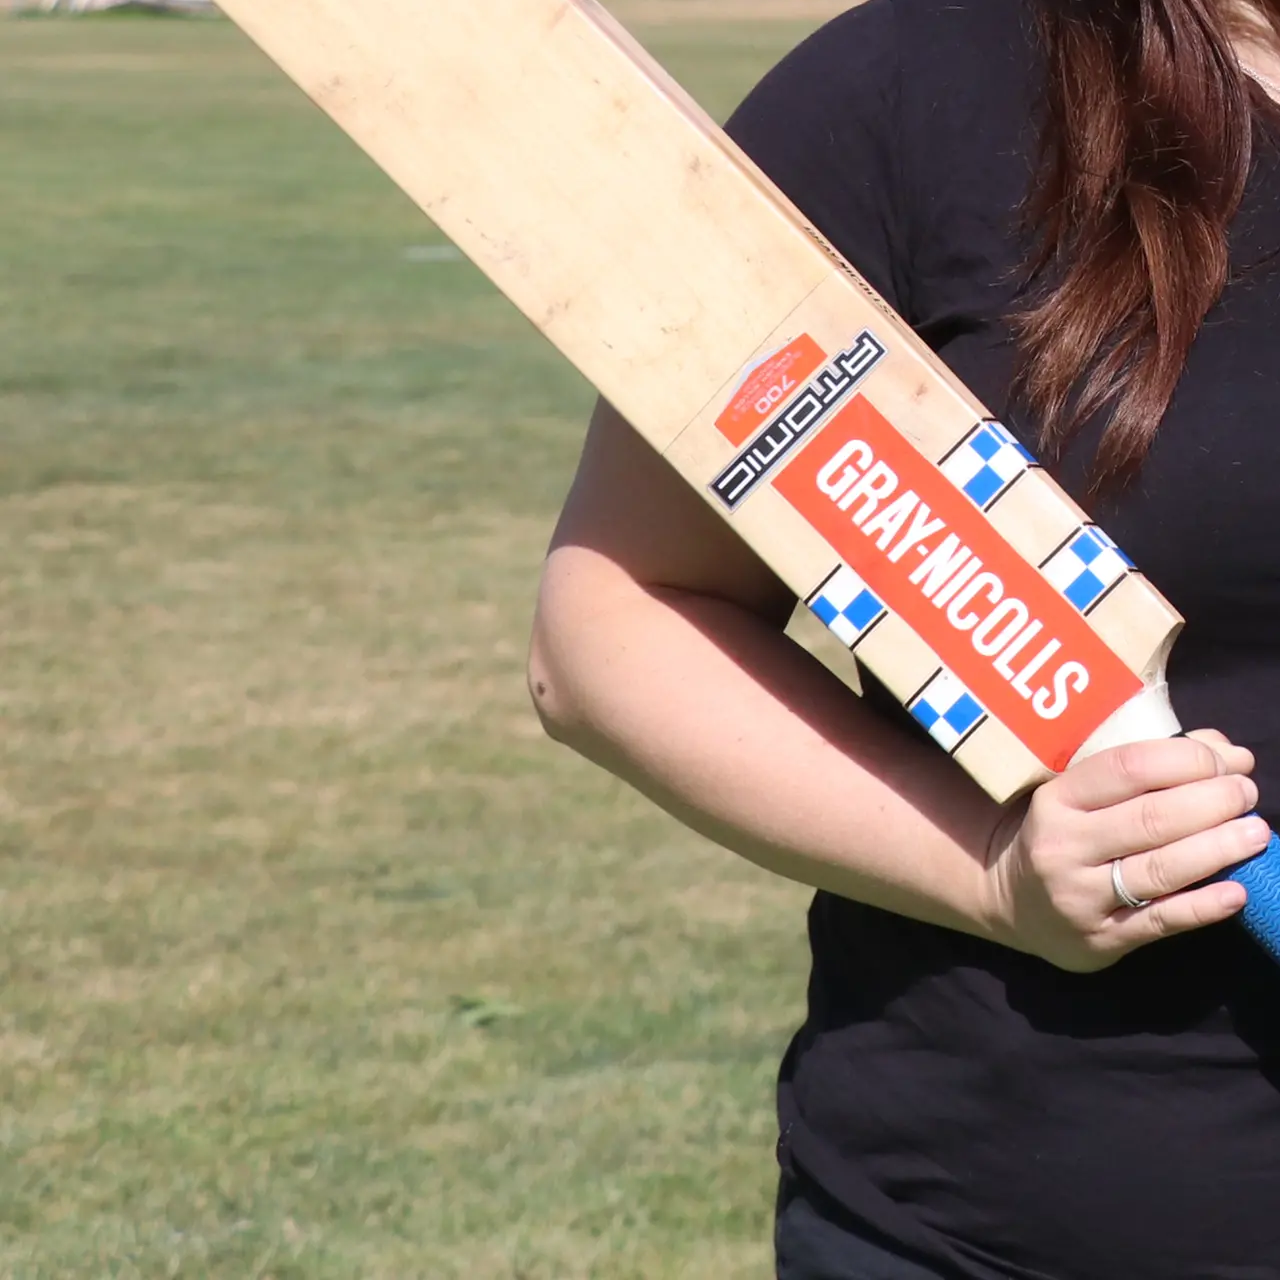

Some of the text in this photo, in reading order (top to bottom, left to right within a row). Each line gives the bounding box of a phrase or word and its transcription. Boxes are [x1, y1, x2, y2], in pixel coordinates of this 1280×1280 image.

[716, 331, 884, 501] ATOMIC
[755, 373, 796, 414] 700
[815, 438, 1090, 720] GRAY-NICOLLS
